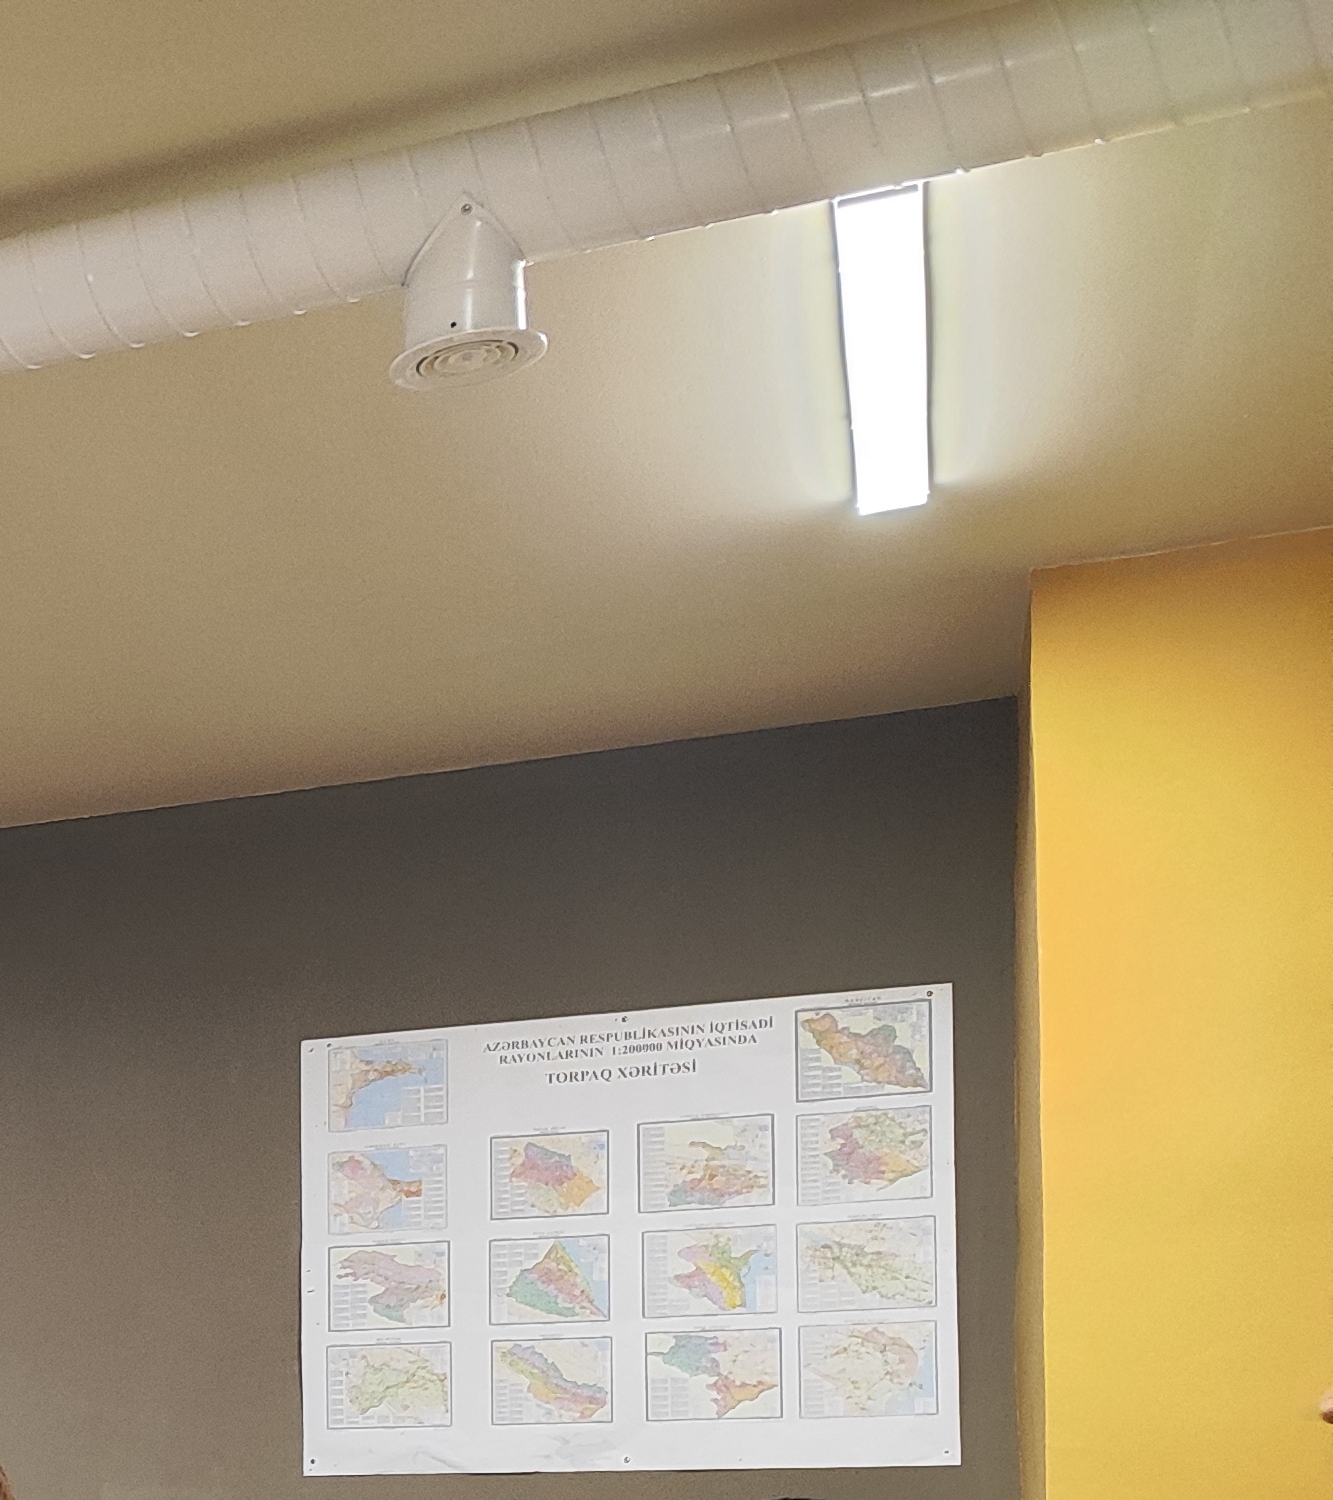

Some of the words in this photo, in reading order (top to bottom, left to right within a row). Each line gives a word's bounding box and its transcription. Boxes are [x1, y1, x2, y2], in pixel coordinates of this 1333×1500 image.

[483, 1034, 576, 1053] AZƏRBAYCAN
[709, 1015, 774, 1034] İQTİSADİ
[499, 1046, 604, 1065] RAYONLARININ
[666, 1033, 758, 1052] MİQYASINDA
[545, 1068, 612, 1085] TORPAQ
[617, 1058, 697, 1080] XƏRİTƏSİ
